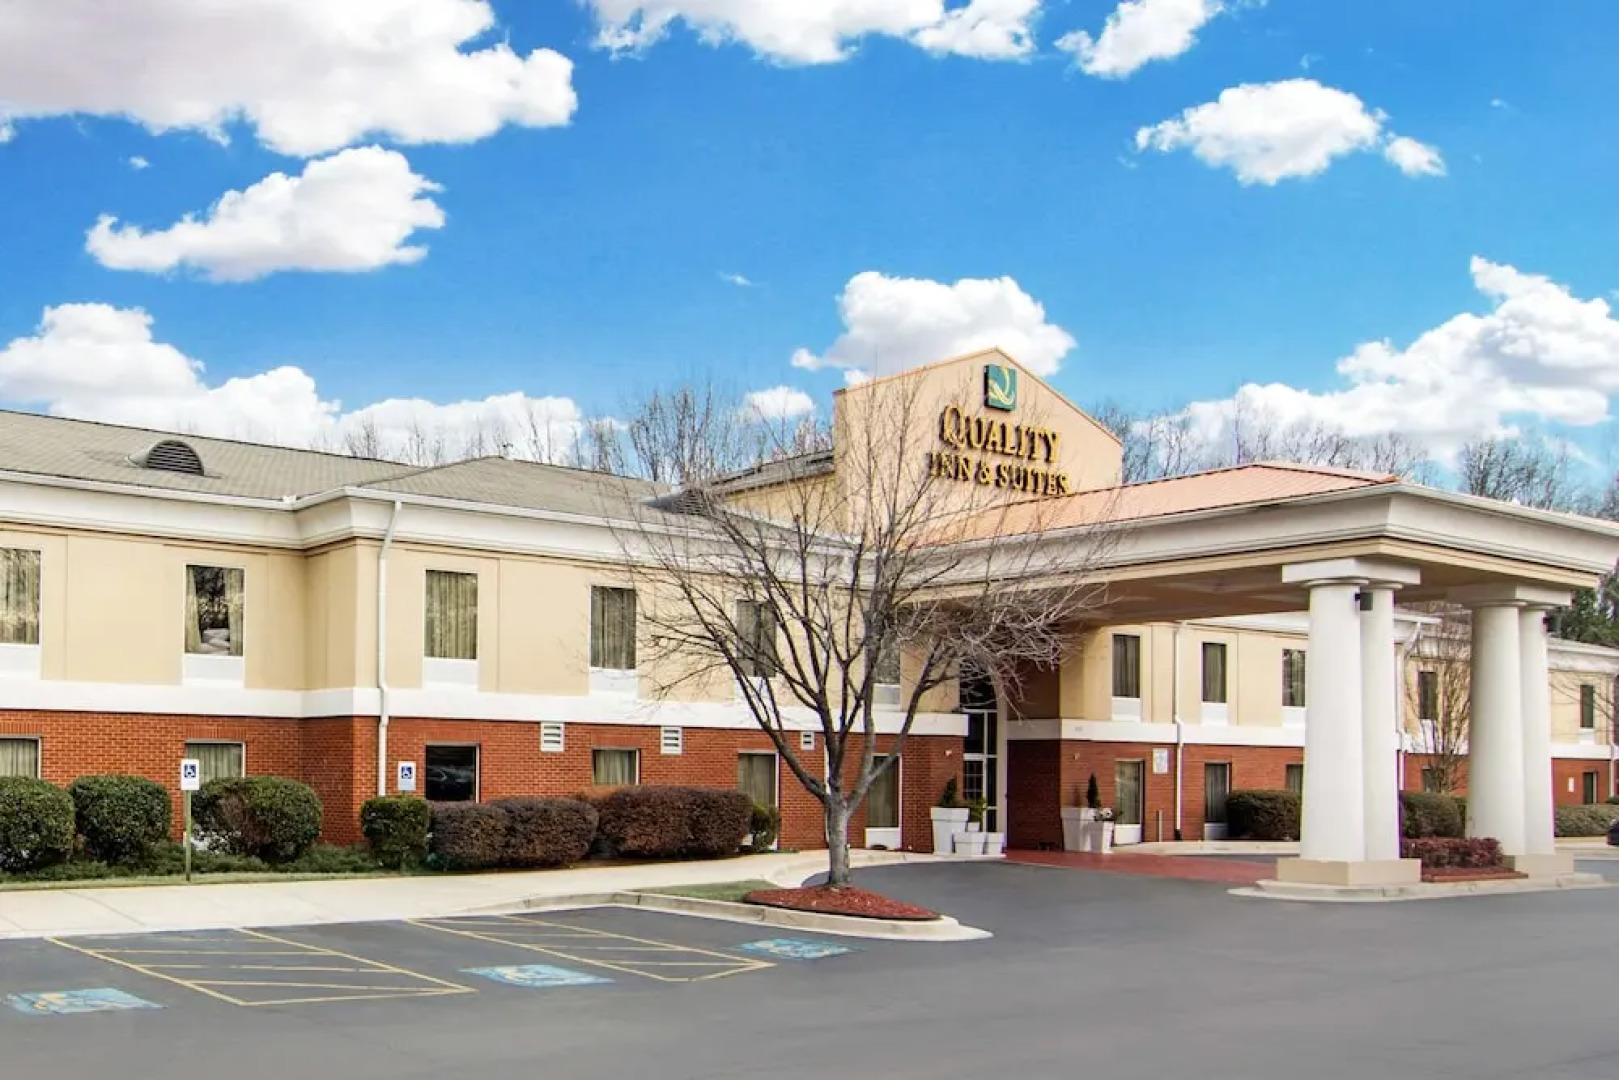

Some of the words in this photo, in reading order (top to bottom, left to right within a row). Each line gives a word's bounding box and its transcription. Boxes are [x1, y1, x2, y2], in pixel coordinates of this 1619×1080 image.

[939, 404, 1061, 463] QUALITY
[926, 450, 973, 482] INN
[975, 460, 991, 485] &
[995, 463, 1071, 496] SUITES
